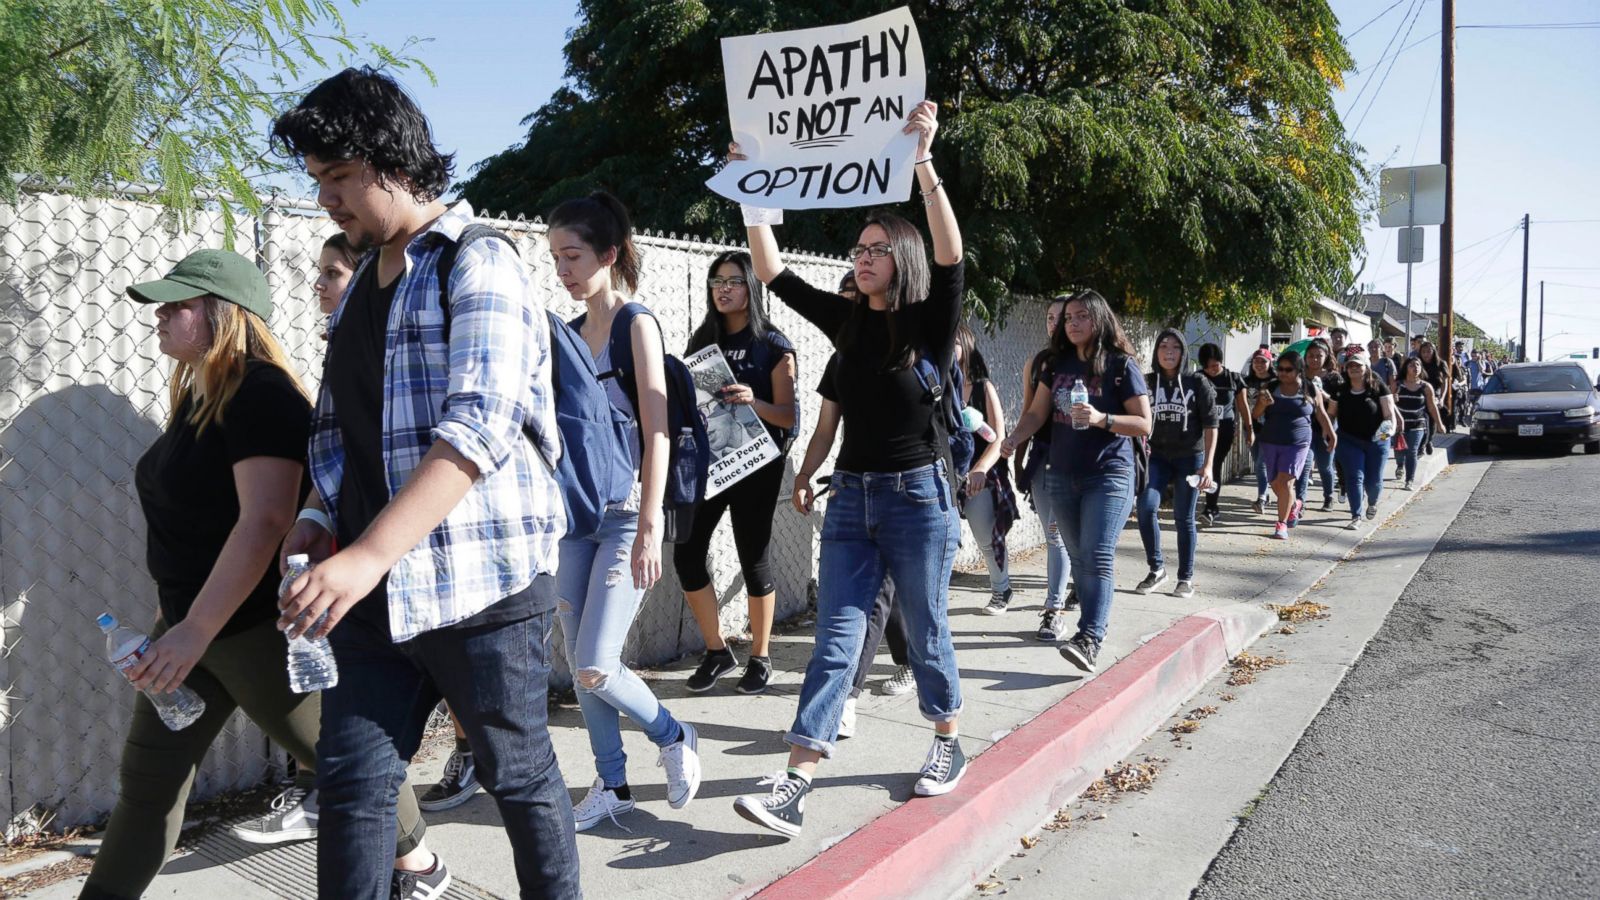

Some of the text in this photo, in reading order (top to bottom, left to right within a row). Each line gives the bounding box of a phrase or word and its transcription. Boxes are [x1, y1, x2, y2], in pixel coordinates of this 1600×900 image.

[748, 24, 910, 100] APATHY
[768, 95, 903, 140] IS NOT AN
[737, 158, 890, 199] OPTION
[714, 453, 766, 487] Since 1962
[715, 457, 736, 471] The
[736, 436, 769, 459] People
